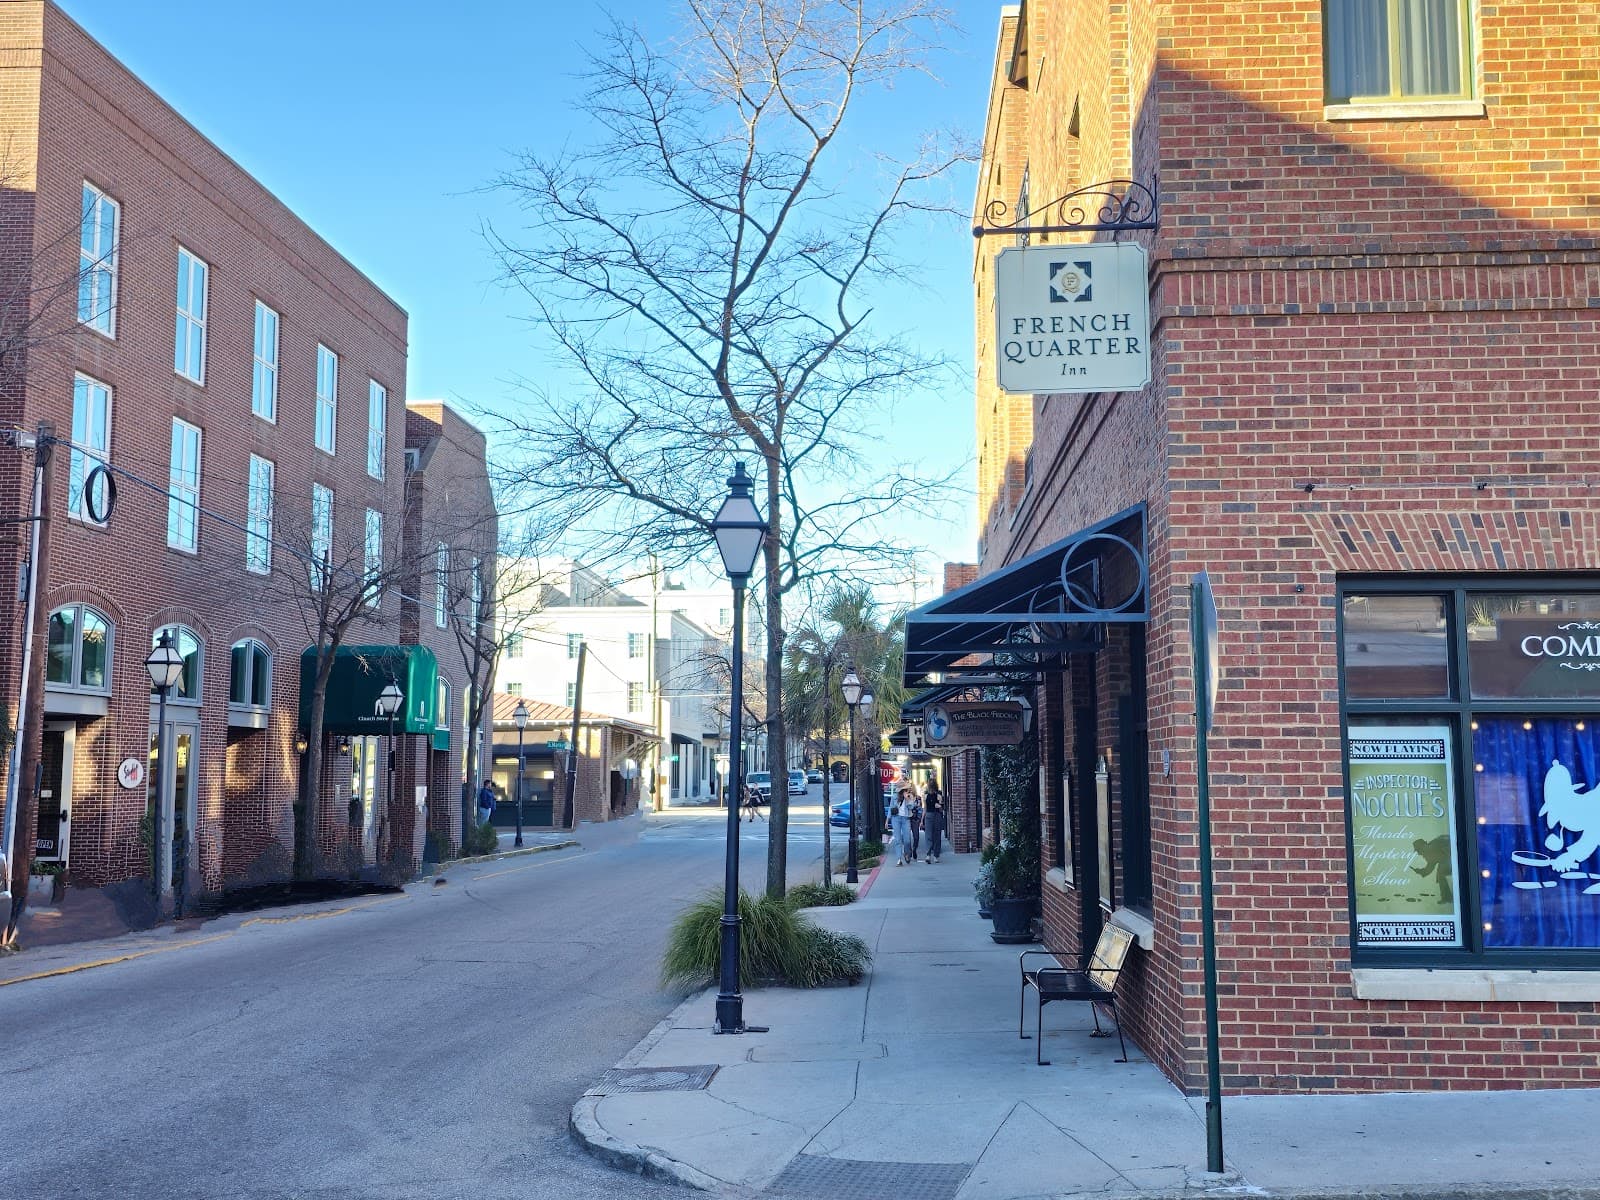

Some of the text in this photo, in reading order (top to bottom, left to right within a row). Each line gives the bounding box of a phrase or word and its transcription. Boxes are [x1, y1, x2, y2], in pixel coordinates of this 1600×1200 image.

[1013, 313, 1131, 335] FRENCH
[1004, 337, 1142, 364] QUARTER
[1061, 363, 1088, 376] Inn
[1354, 744, 1439, 754] NOW PLAYING
[880, 768, 894, 778] TOP
[1366, 774, 1428, 790] INSPECTOR
[1354, 825, 1414, 840] Murder
[1352, 844, 1419, 872] Mystery
[1363, 865, 1410, 886] Show
[1363, 927, 1449, 936] NOW PLAYING
